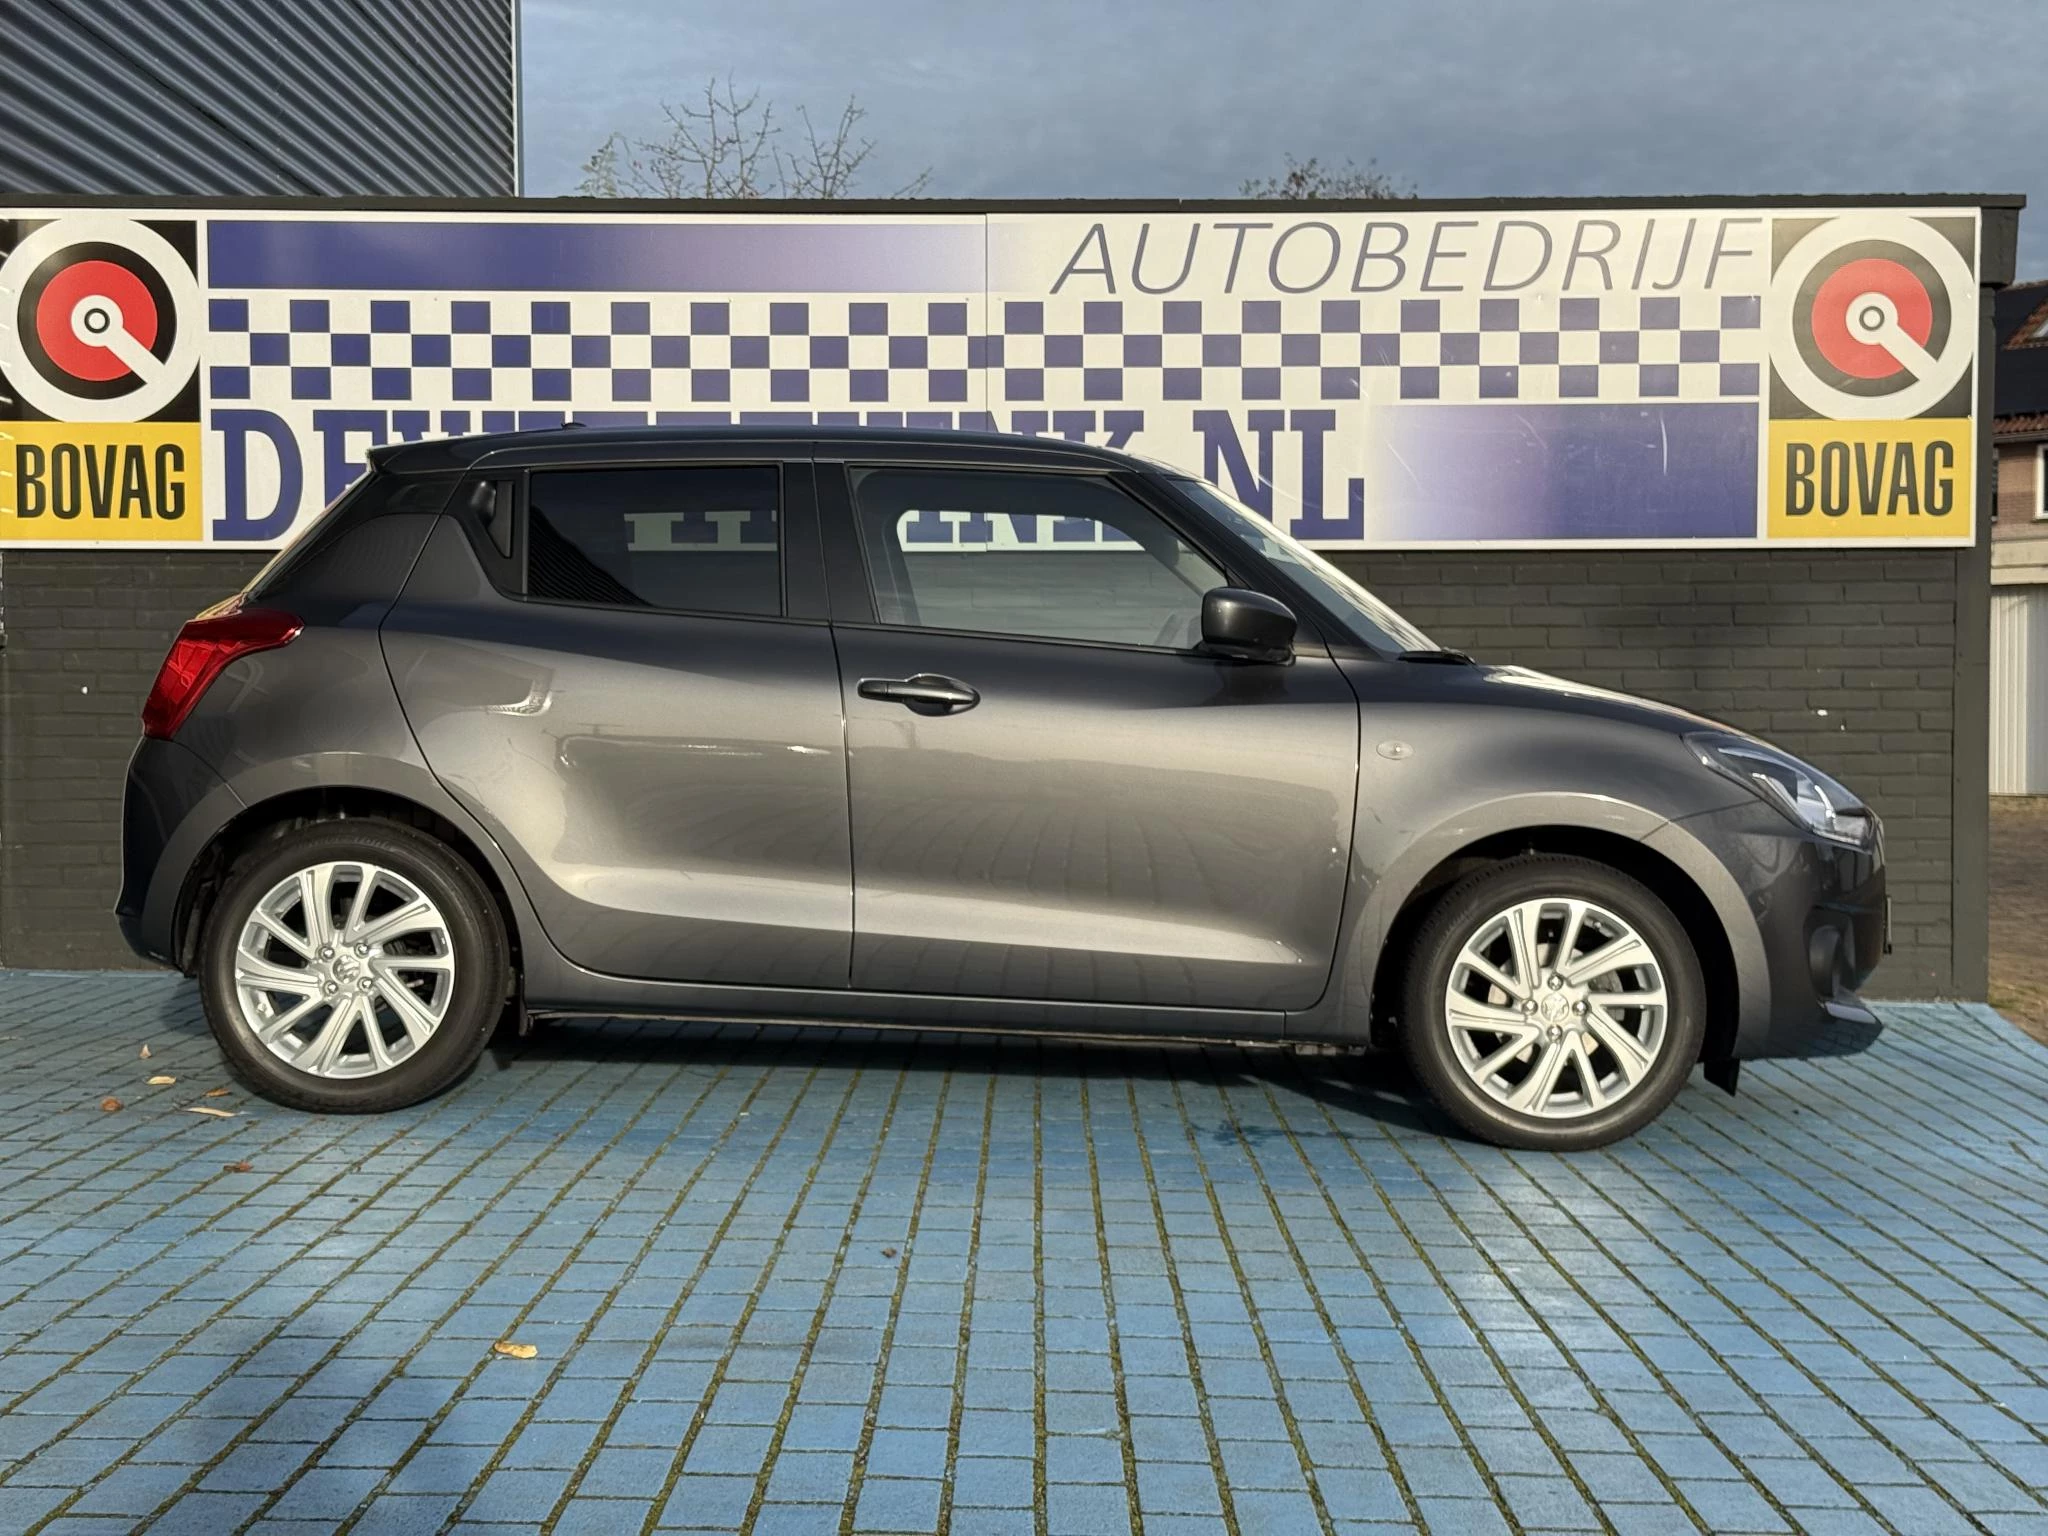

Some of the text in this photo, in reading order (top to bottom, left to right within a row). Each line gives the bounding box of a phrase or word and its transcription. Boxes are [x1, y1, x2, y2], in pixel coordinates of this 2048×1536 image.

[1049, 217, 1763, 295] AUTOBEDRIJF
[16, 443, 185, 520] BOVAG
[1785, 440, 1954, 517] BOVAG
